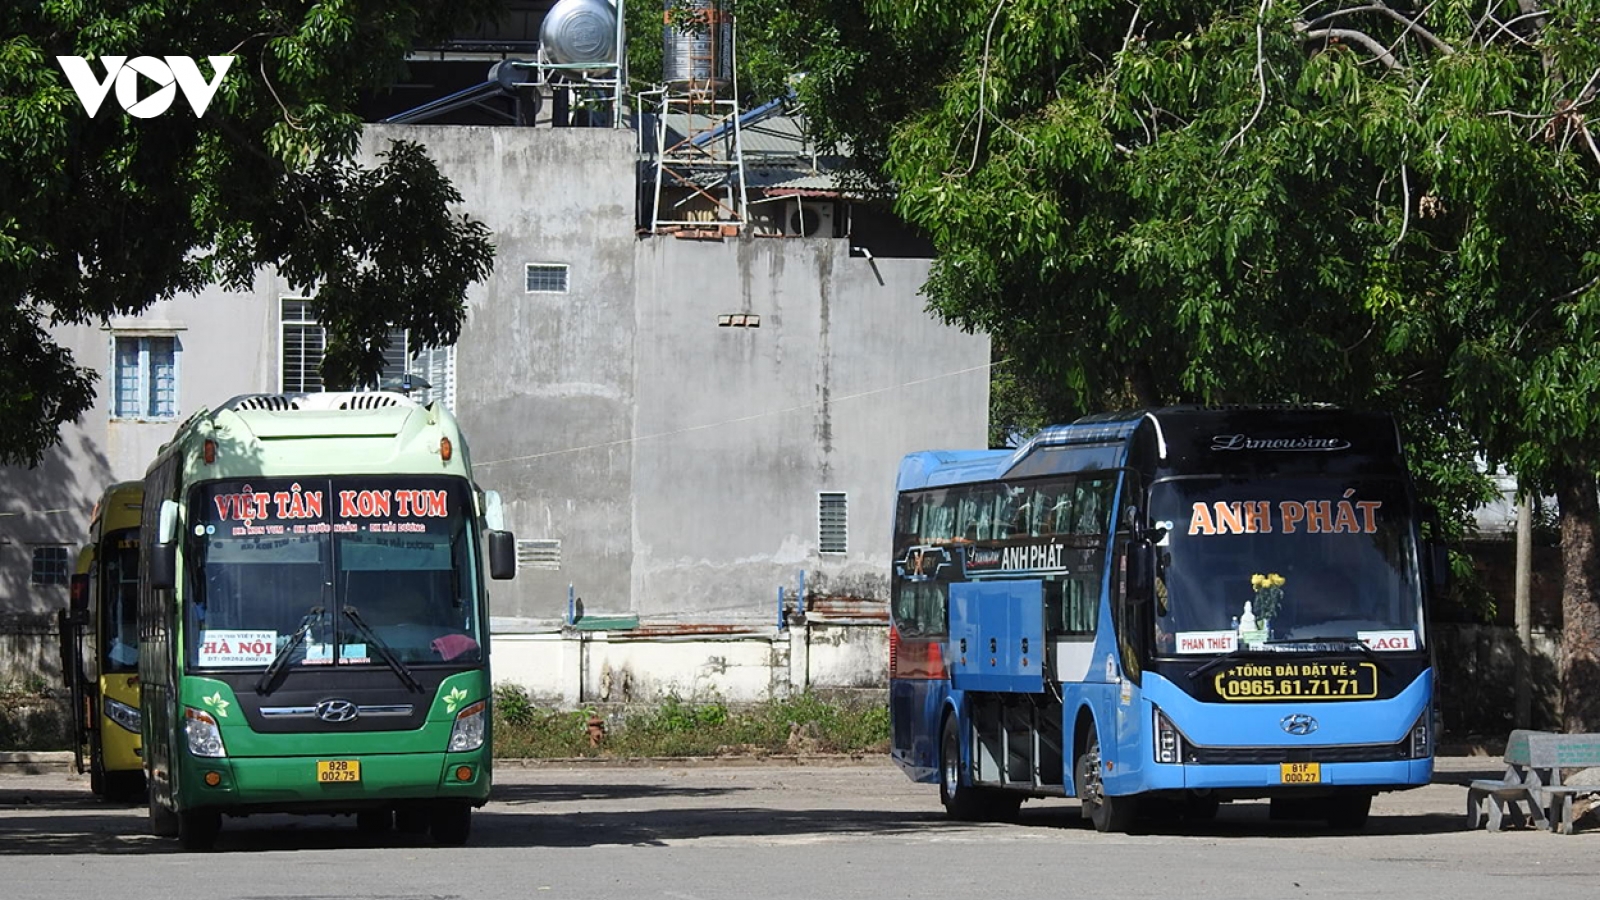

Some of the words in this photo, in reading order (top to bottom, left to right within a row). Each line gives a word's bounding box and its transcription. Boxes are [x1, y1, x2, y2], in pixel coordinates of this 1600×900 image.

[1210, 434, 1351, 451] Limousine
[214, 484, 270, 527] VIỆT
[274, 483, 323, 518] TÂN
[339, 490, 390, 517] KON
[395, 489, 448, 517] TUM
[1188, 501, 1272, 535] ANH
[1279, 488, 1382, 534] PHÁT
[1001, 545, 1031, 570] ANH
[1031, 538, 1064, 569] PHÁT
[203, 639, 232, 654] HÀ
[238, 639, 273, 656] NỘI
[1182, 639, 1204, 649] PHAN
[1208, 637, 1232, 649] THIẾT
[1236, 662, 1271, 677] TỔNG
[1275, 663, 1299, 677] ĐÀI
[1302, 662, 1327, 678] ĐẶT
[1331, 662, 1348, 676] VÉ
[1228, 679, 1358, 695] 0965.61.71.71
[329, 761, 348, 770] 82B
[321, 771, 355, 781] 002.75
[1285, 773, 1317, 782] 000.27
